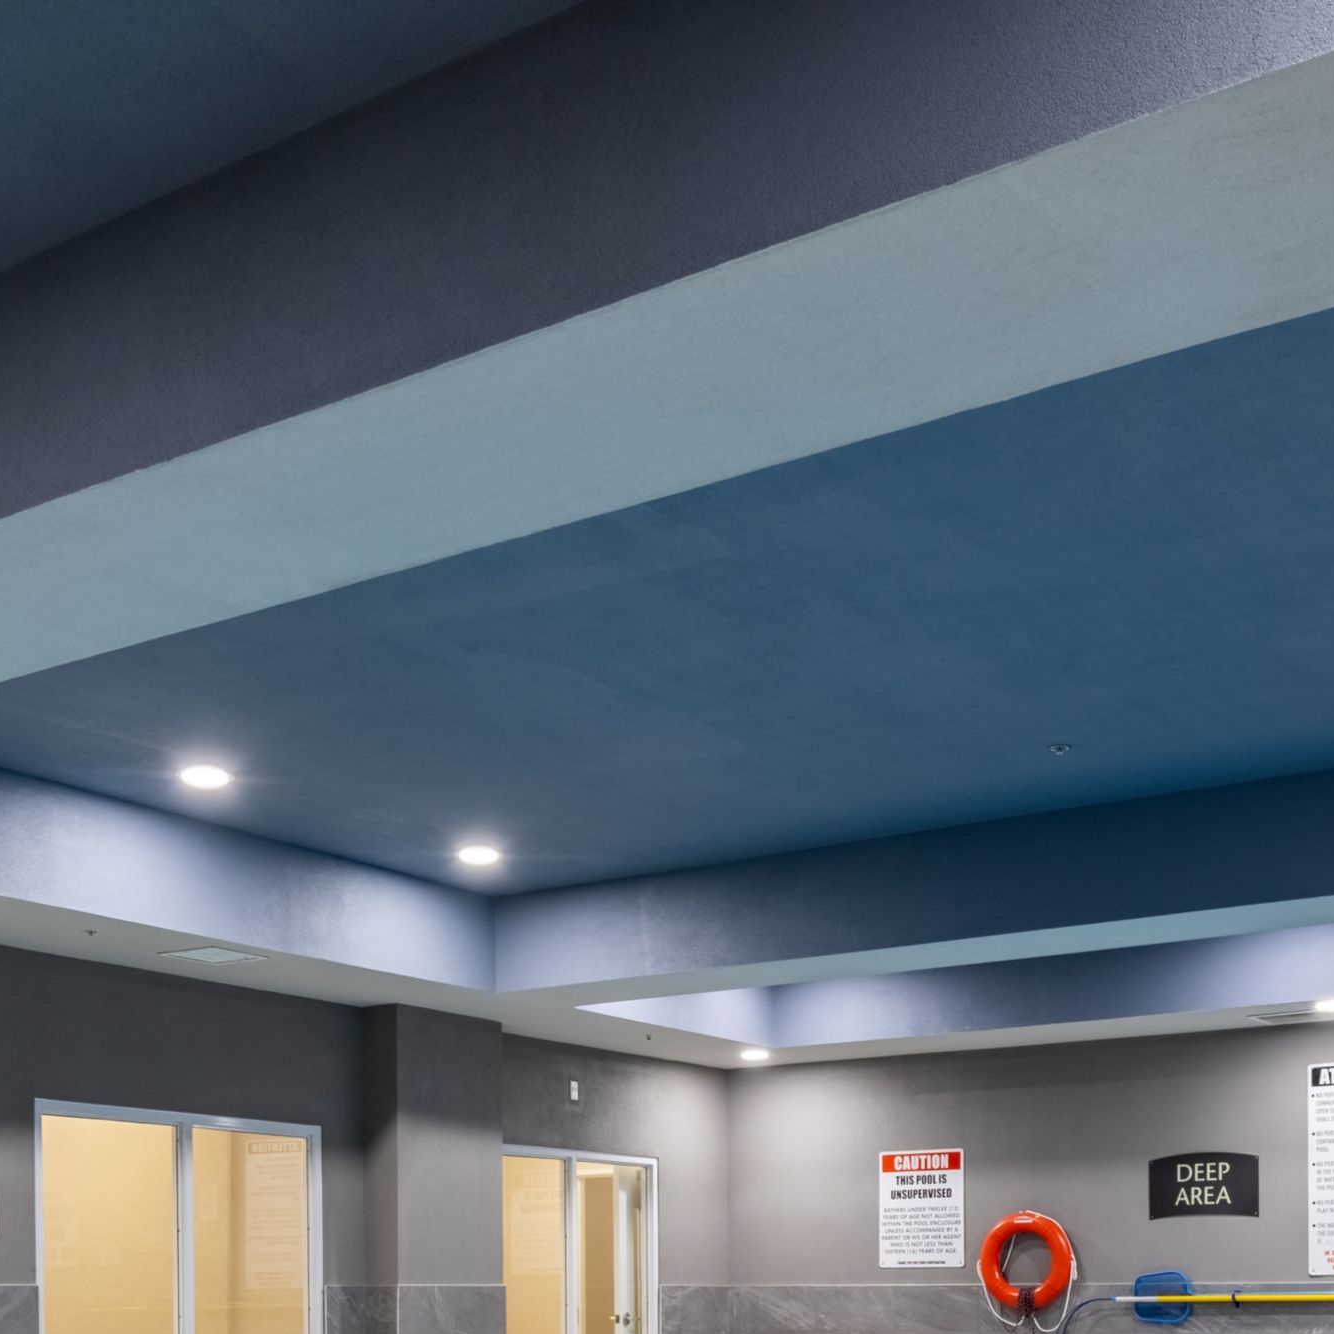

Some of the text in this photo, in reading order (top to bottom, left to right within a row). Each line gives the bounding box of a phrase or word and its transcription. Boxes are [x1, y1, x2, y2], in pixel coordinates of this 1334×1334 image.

[894, 1154, 948, 1170] CAUTION
[896, 1174, 947, 1185] THIS POOL IS
[1177, 1162, 1230, 1182] DEEP
[891, 1188, 952, 1200] UNSUPERVISED
[1175, 1186, 1231, 1206] AREA
